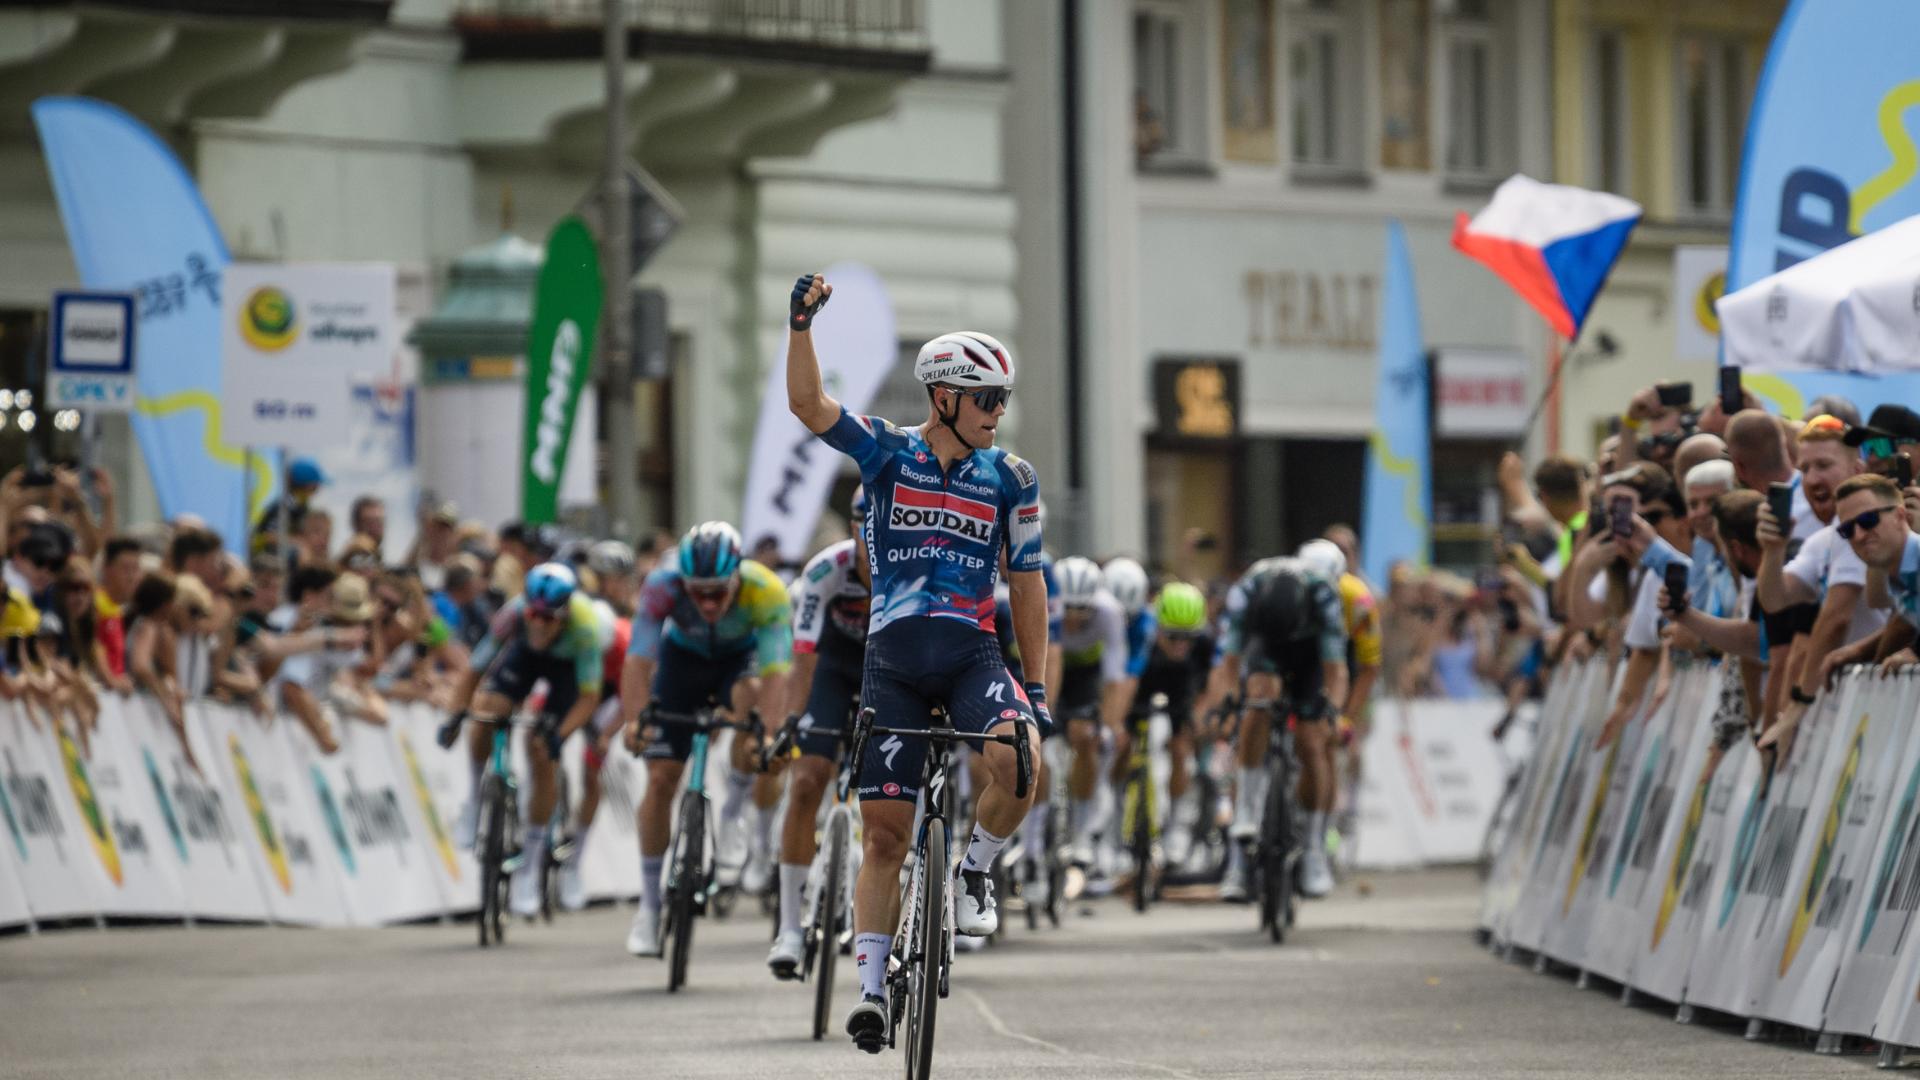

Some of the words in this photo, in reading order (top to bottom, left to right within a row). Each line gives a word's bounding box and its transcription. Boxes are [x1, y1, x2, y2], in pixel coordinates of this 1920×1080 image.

[922, 364, 977, 381] SPECIALIZED
[900, 463, 941, 485] Ekopak
[951, 479, 995, 494] NAPOLEON
[891, 506, 990, 542] SOUDAL
[866, 505, 879, 575] SOUDAL
